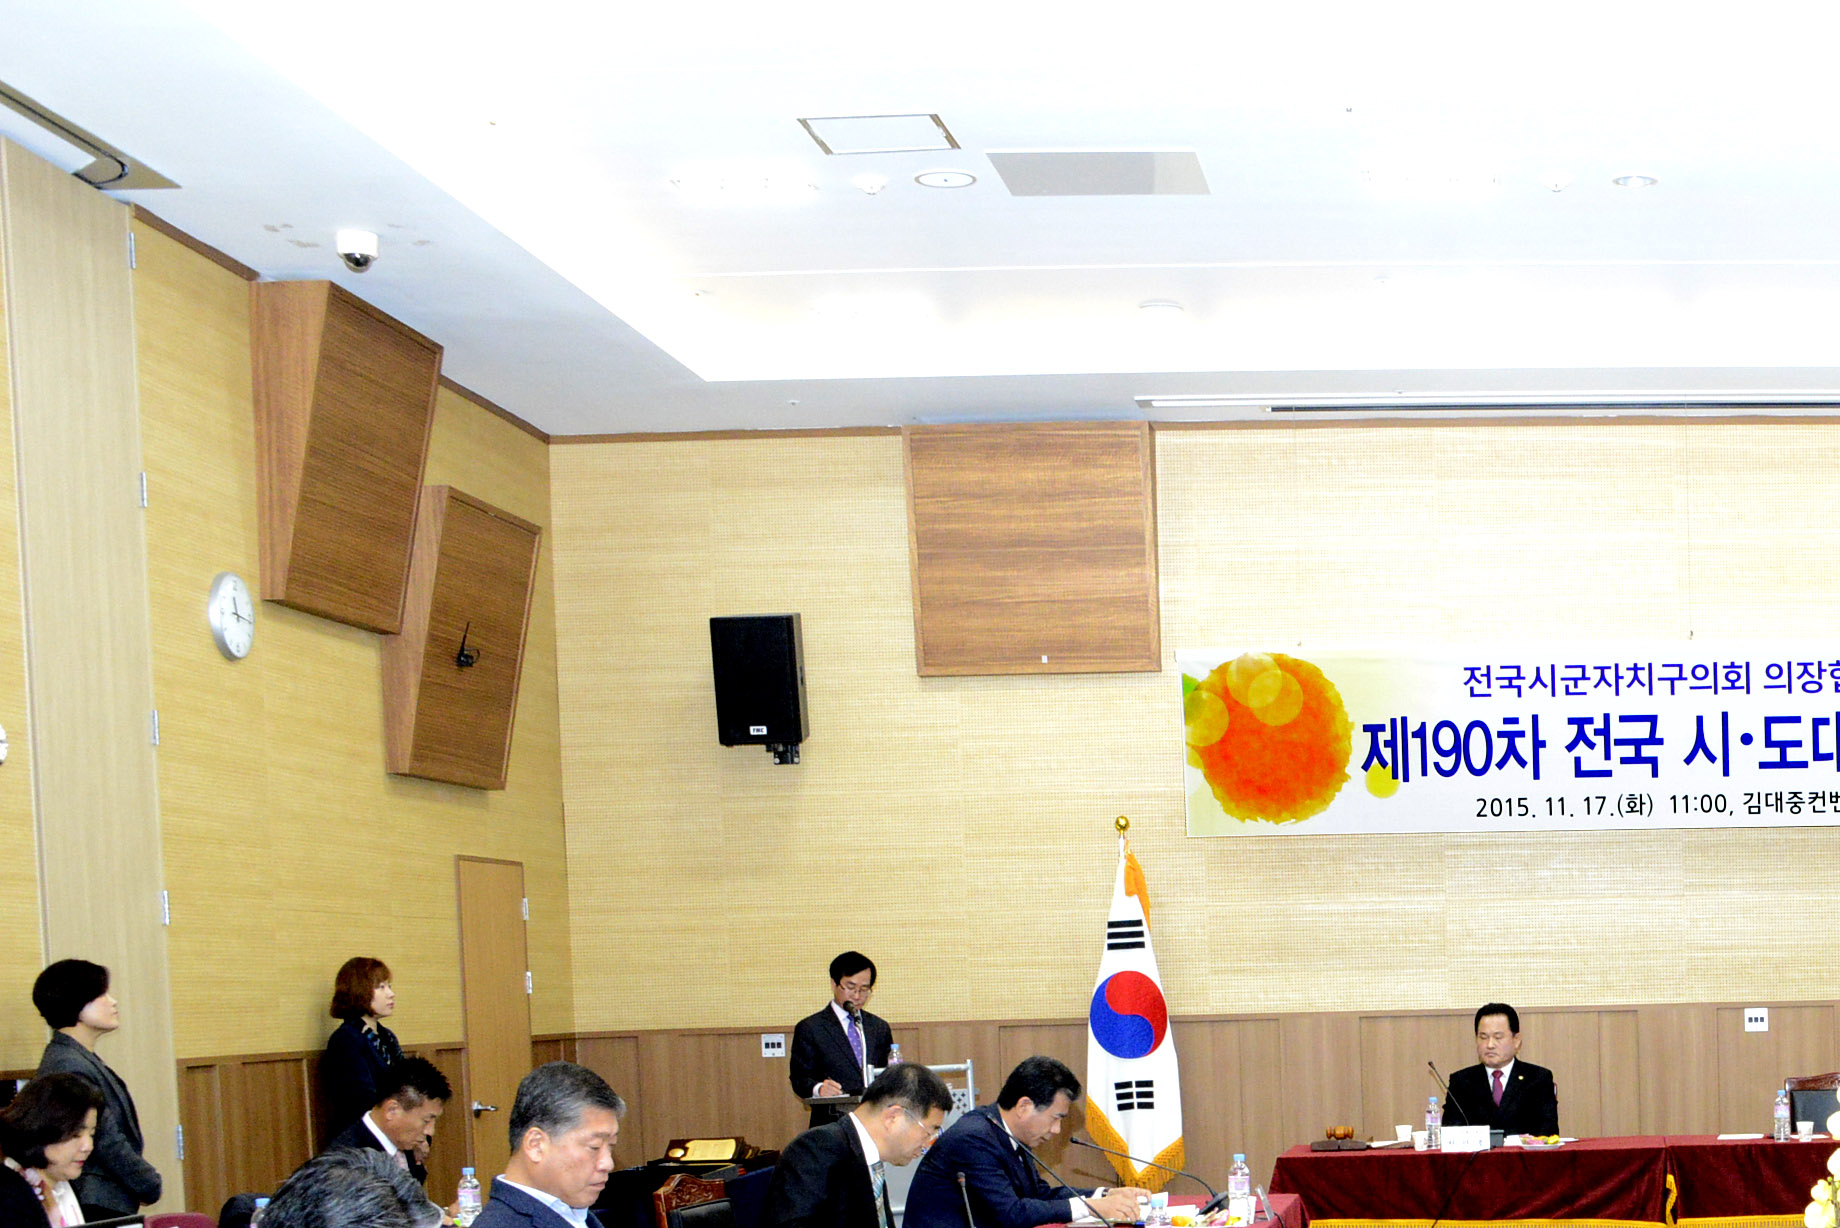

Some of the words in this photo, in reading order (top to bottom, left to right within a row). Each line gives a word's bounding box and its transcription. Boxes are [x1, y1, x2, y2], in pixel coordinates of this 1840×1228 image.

[1463, 661, 1752, 698] 전국시군자치구의회
[1360, 713, 1547, 784] 제190차
[1564, 712, 1666, 779] 전국
[1475, 795, 1537, 819] 2015.
[1544, 796, 1575, 818] 11.
[1583, 793, 1654, 817] 17.(화)
[1669, 793, 1734, 817] 11:00,
